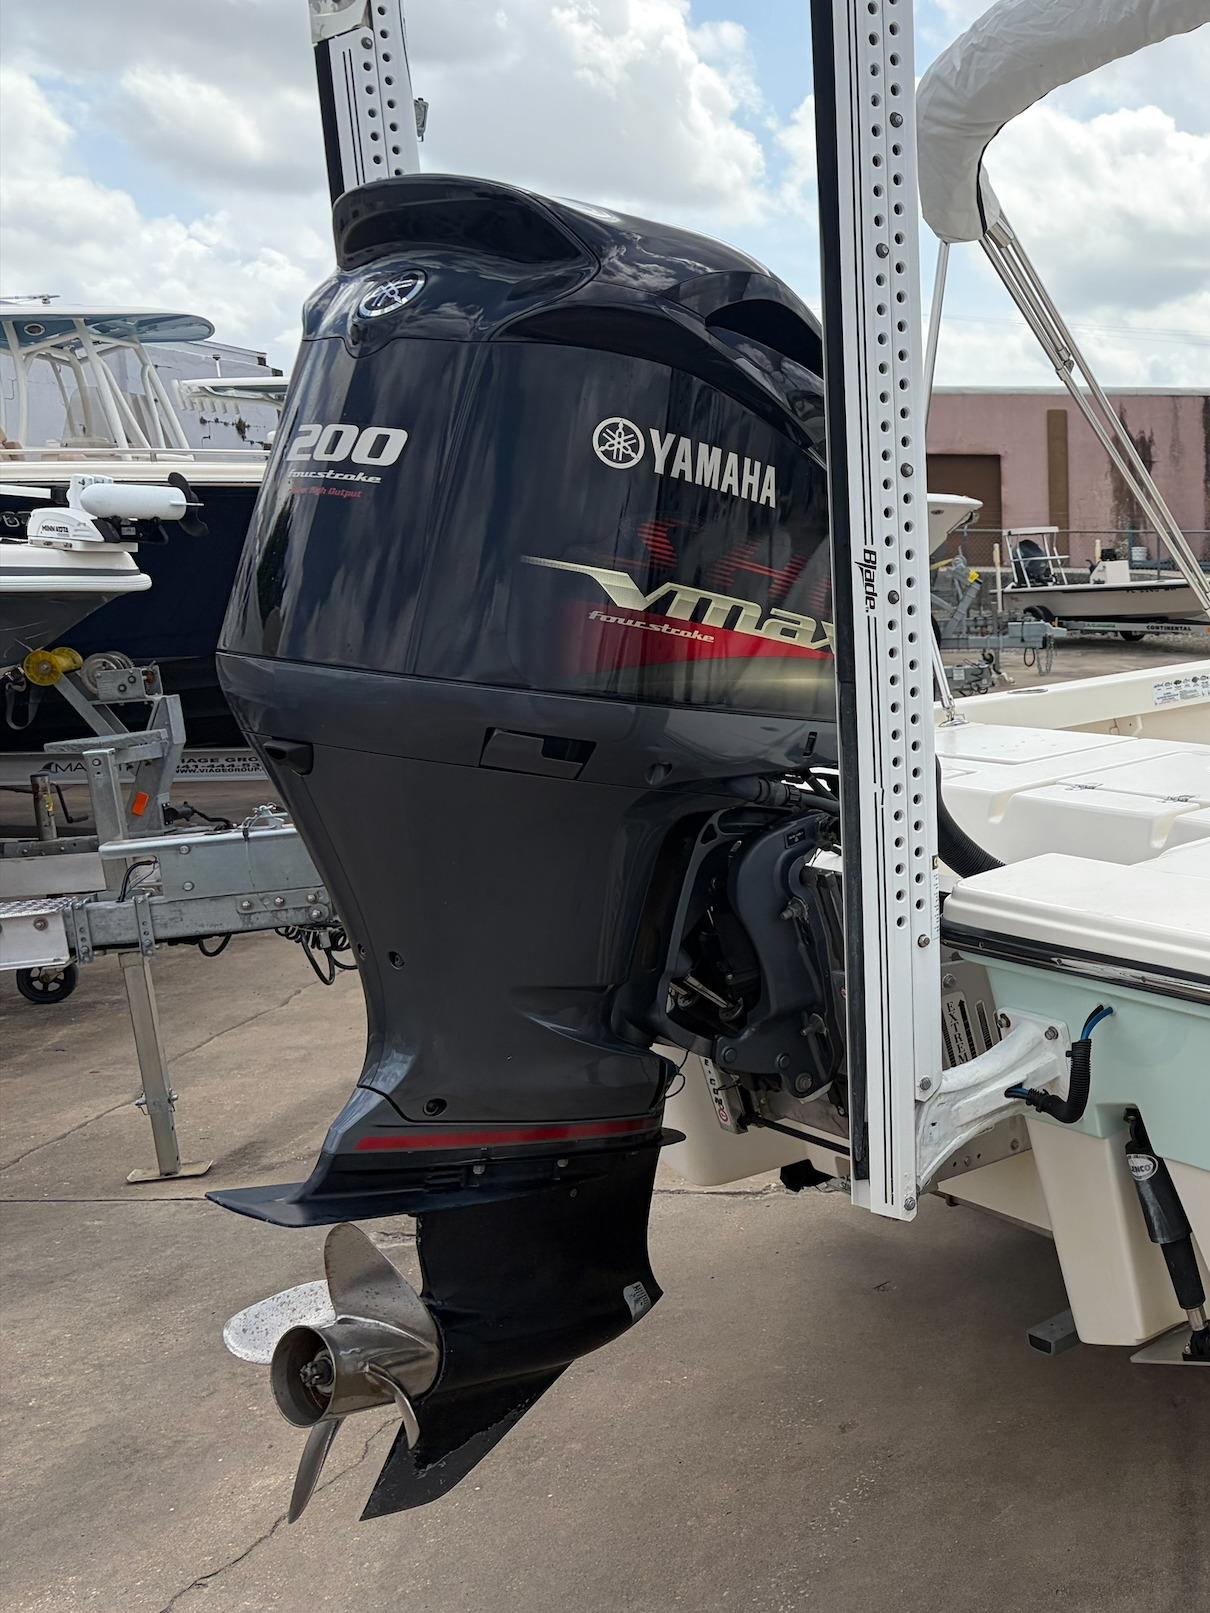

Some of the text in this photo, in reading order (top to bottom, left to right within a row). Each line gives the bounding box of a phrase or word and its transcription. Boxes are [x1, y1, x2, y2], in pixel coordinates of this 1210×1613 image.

[286, 424, 408, 466] 200
[650, 428, 776, 508] YAMAHA
[854, 549, 878, 611] Blade
[589, 610, 714, 643] fourstroke
[1146, 624, 1192, 632] CONTINENTAL
[946, 1001, 969, 1065] EXTREM
